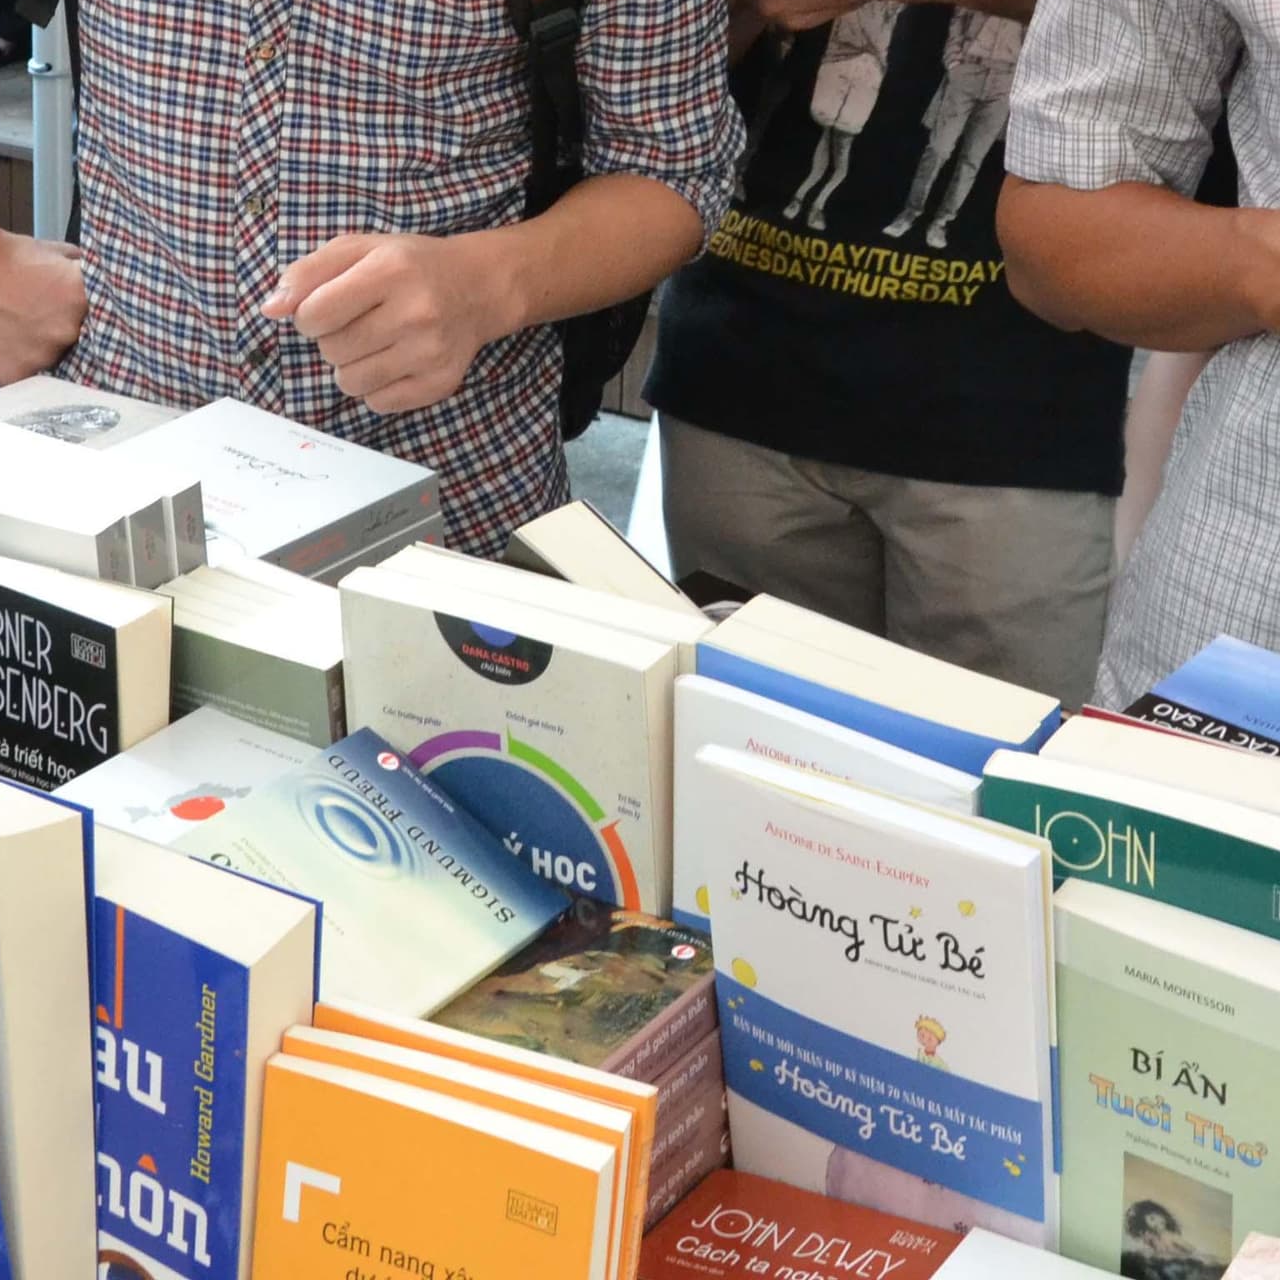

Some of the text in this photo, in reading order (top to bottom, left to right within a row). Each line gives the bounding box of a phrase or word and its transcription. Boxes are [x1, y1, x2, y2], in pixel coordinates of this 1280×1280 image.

[461, 643, 491, 664] DANA
[1152, 702, 1199, 730] SAO
[14, 744, 44, 772] triết
[48, 757, 77, 783] học
[328, 754, 404, 824] FREUD
[765, 821, 817, 853] ANTOINE
[407, 825, 516, 925] SIGMUND
[735, 860, 865, 963] Hoàng
[869, 913, 927, 962] Tử
[935, 931, 986, 980] Bé
[1124, 964, 1236, 1017] MARIA MONTESSORI
[96, 990, 167, 1116] ấu
[190, 983, 218, 1185] Howard Gardner
[1130, 1046, 1228, 1107] BÍ ẨN
[774, 1058, 967, 1161] Hoàng Tử Bé
[859, 1071, 886, 1097] NIỆM
[887, 1083, 900, 1100] 70
[927, 1099, 943, 1118] RA
[1088, 1071, 1172, 1134] Tuổi
[97, 1149, 212, 1269] hôn
[321, 1219, 436, 1280] Cẩm nang
[675, 1234, 741, 1267] Cách
[744, 1253, 771, 1275] ta
[691, 1203, 796, 1253] JOHN
[792, 1232, 906, 1280] DEWEY
